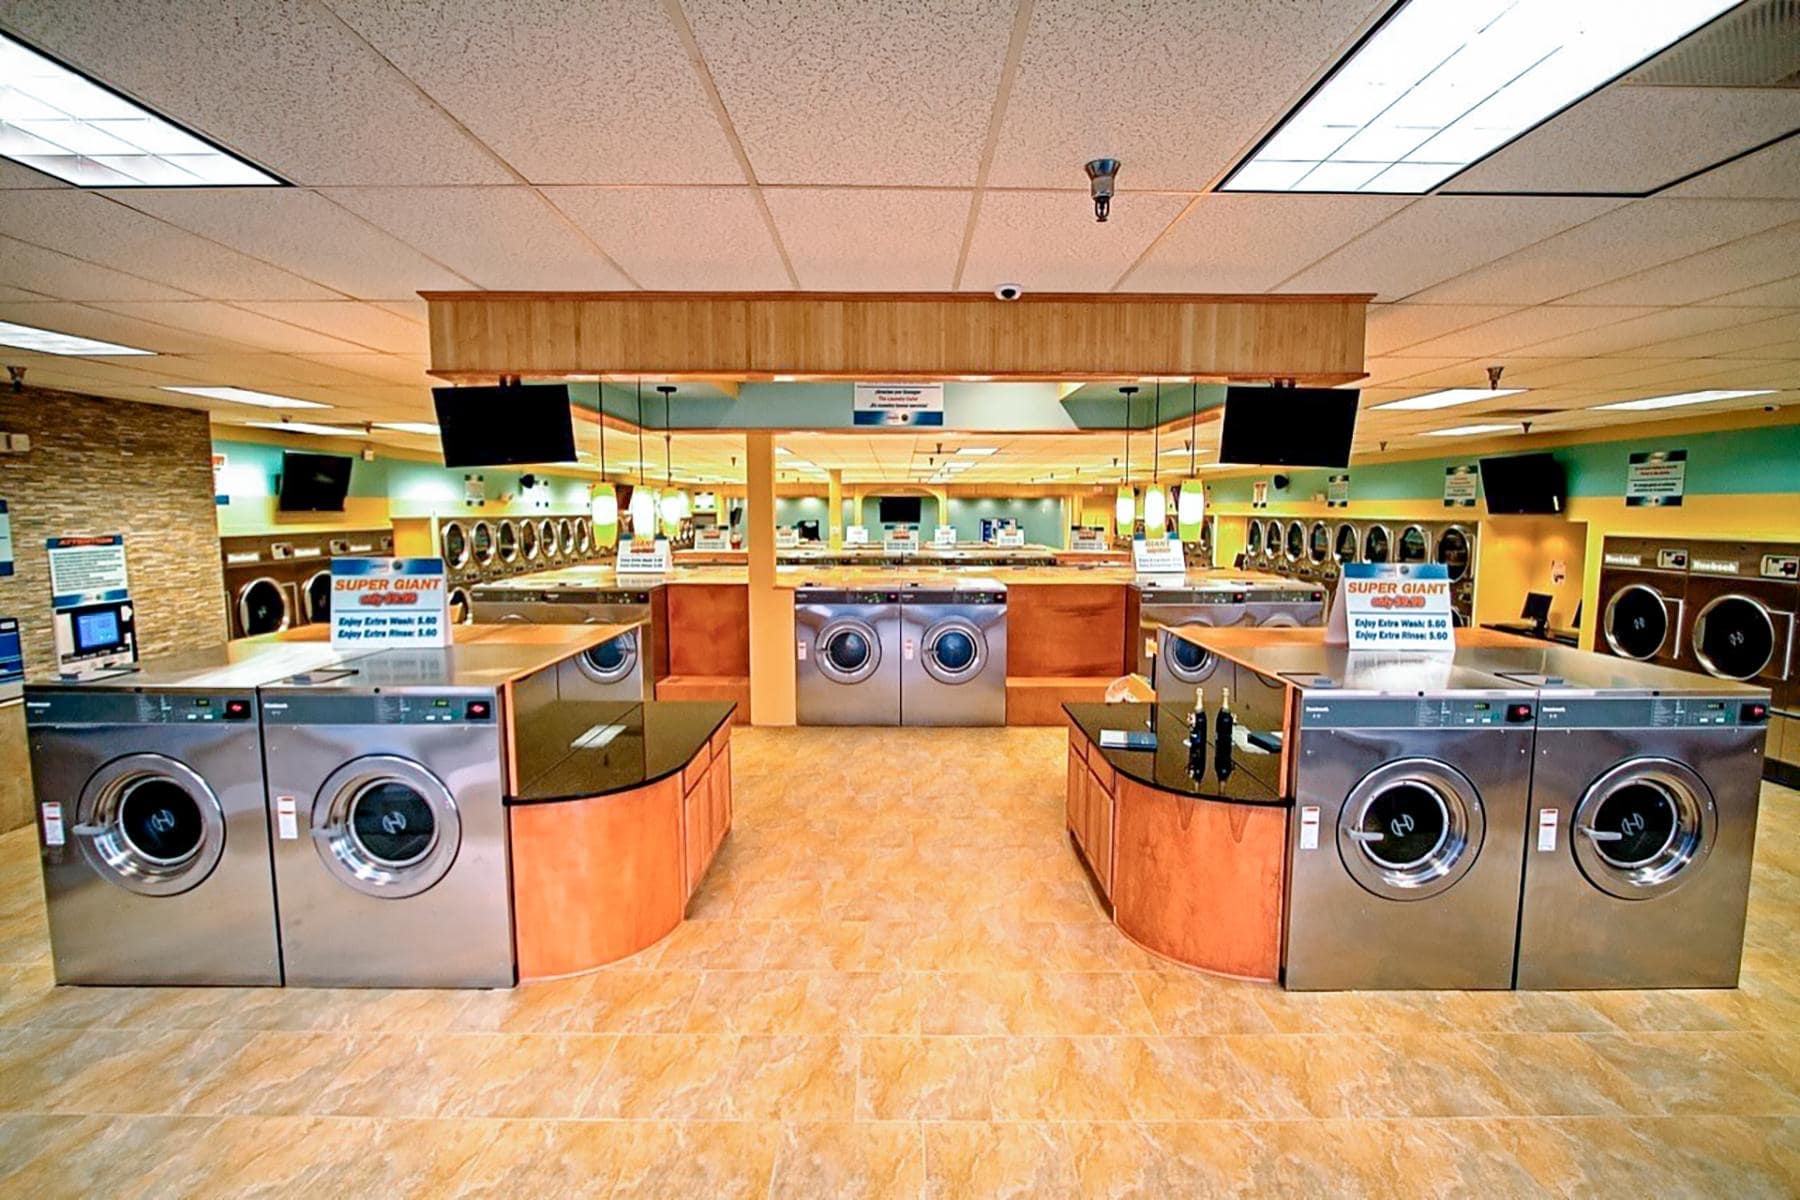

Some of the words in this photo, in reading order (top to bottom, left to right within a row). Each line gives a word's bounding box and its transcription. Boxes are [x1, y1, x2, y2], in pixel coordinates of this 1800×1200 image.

[335, 579, 389, 590] SUPER
[394, 579, 441, 590] GIANT
[1348, 582, 1398, 594] SUPER
[1402, 583, 1447, 594] GIANT
[338, 617, 362, 627] Enjoy
[364, 617, 387, 626] Extra
[1355, 619, 1377, 629] Enjoy
[1378, 619, 1399, 628] Extra
[338, 629, 362, 639] Enjoy
[364, 629, 387, 638] Extra
[1355, 631, 1377, 641] Enjoy
[1379, 631, 1400, 640] Extra
